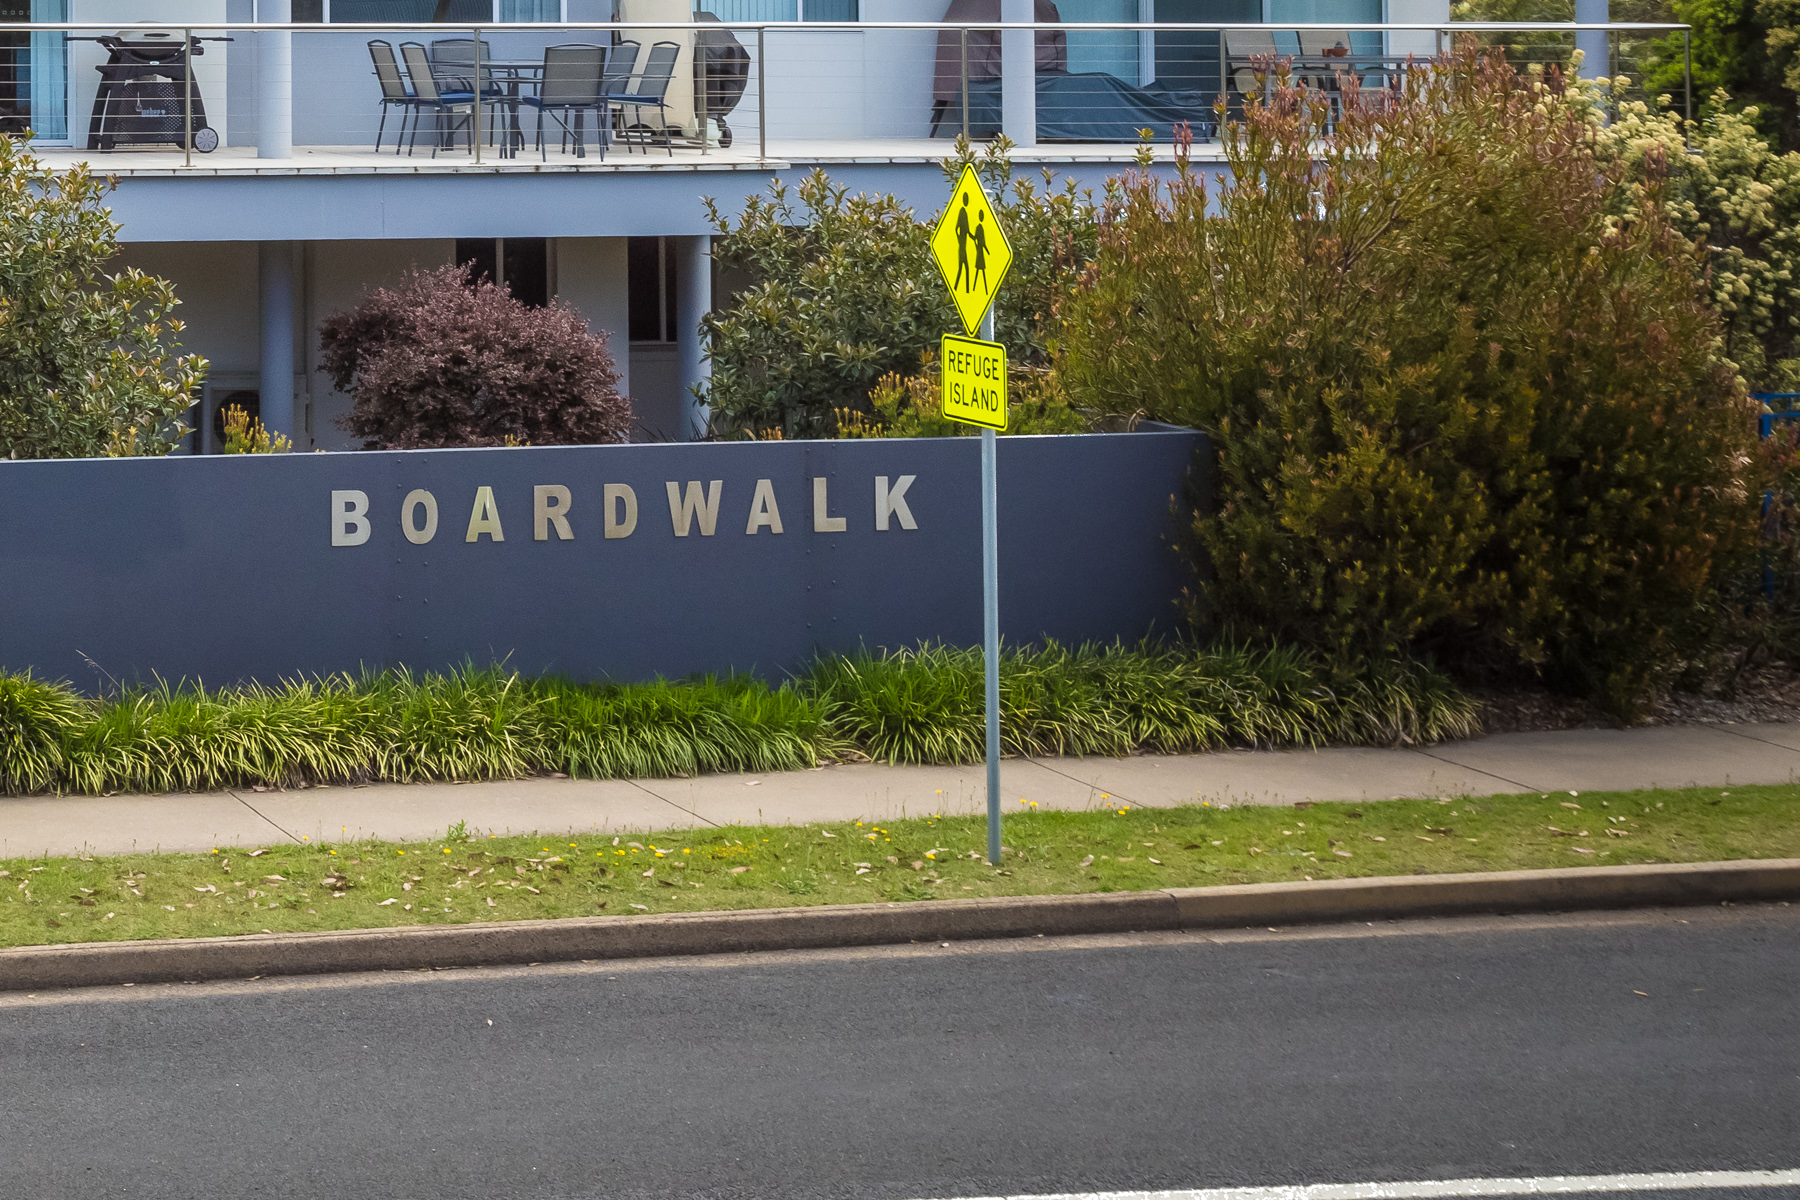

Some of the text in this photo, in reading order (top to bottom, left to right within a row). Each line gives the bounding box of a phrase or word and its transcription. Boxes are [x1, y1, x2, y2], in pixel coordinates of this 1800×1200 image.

[948, 349, 1000, 381] REFUGE
[949, 381, 999, 412] ISLAND
[331, 475, 918, 547] BOARDWALK
